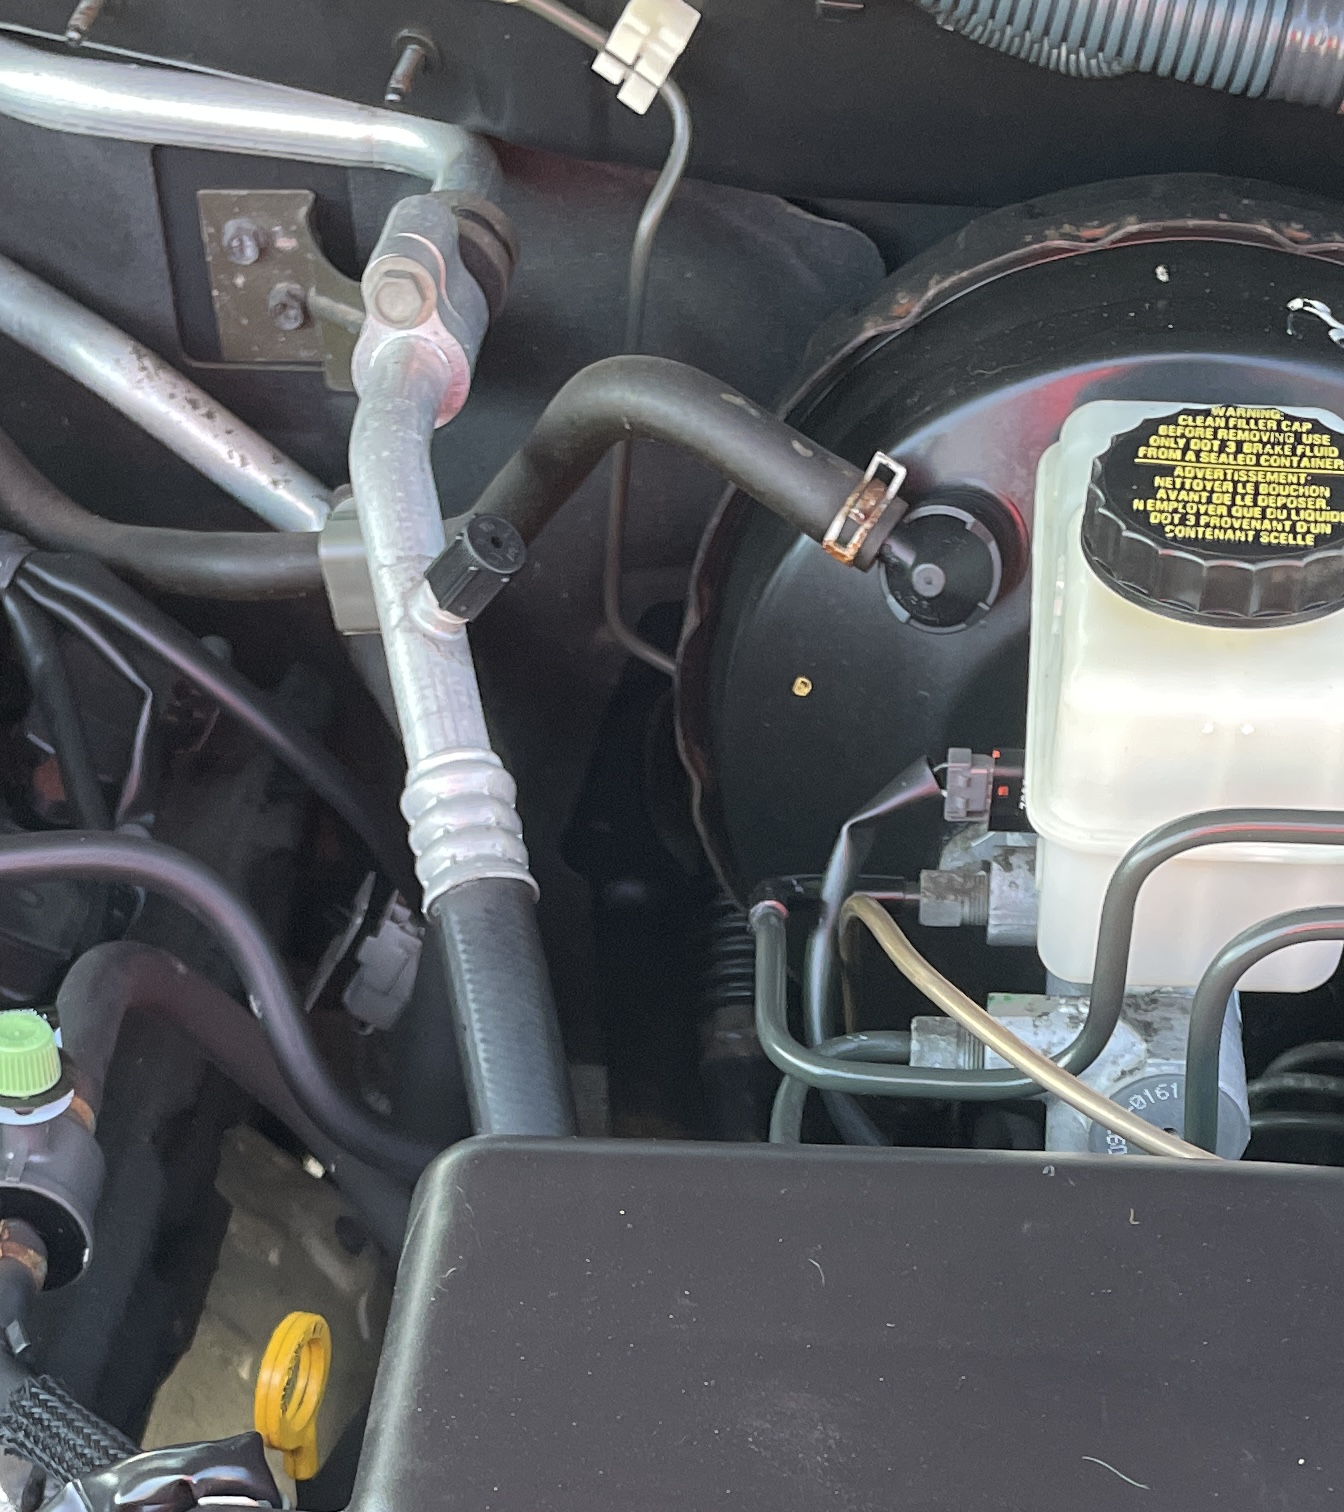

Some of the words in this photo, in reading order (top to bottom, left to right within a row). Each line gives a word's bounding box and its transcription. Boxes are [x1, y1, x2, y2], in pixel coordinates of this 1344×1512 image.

[1178, 415, 1226, 428] CLEAN
[1228, 418, 1277, 431] FILLER
[1280, 421, 1312, 433] CAP
[1158, 425, 1215, 440] BEFORE
[1301, 433, 1331, 446] USE
[1137, 446, 1183, 461] FROM
[1184, 450, 1197, 462] A
[1199, 451, 1257, 466] SEALED
[1149, 435, 1187, 449] ONLY
[1189, 438, 1221, 452] DOT
[1225, 441, 1237, 453] 3
[1242, 442, 1293, 456] BRAKE
[1296, 445, 1340, 458] FLUID
[1154, 476, 1234, 493] NETTOYER
[1237, 482, 1256, 495] LE
[1258, 483, 1331, 498] BOUCHON
[1156, 488, 1210, 503] AVANT
[1212, 492, 1232, 506] DE
[1235, 494, 1254, 507] LE
[1149, 511, 1182, 526] DOT
[1185, 514, 1196, 526] 3
[1199, 515, 1293, 533] PROVENANT
[1231, 505, 1262, 519] QUE
[1266, 507, 1288, 520] DU
[1164, 525, 1256, 544] CONTENANT
[1259, 531, 1315, 547] SCELLE
